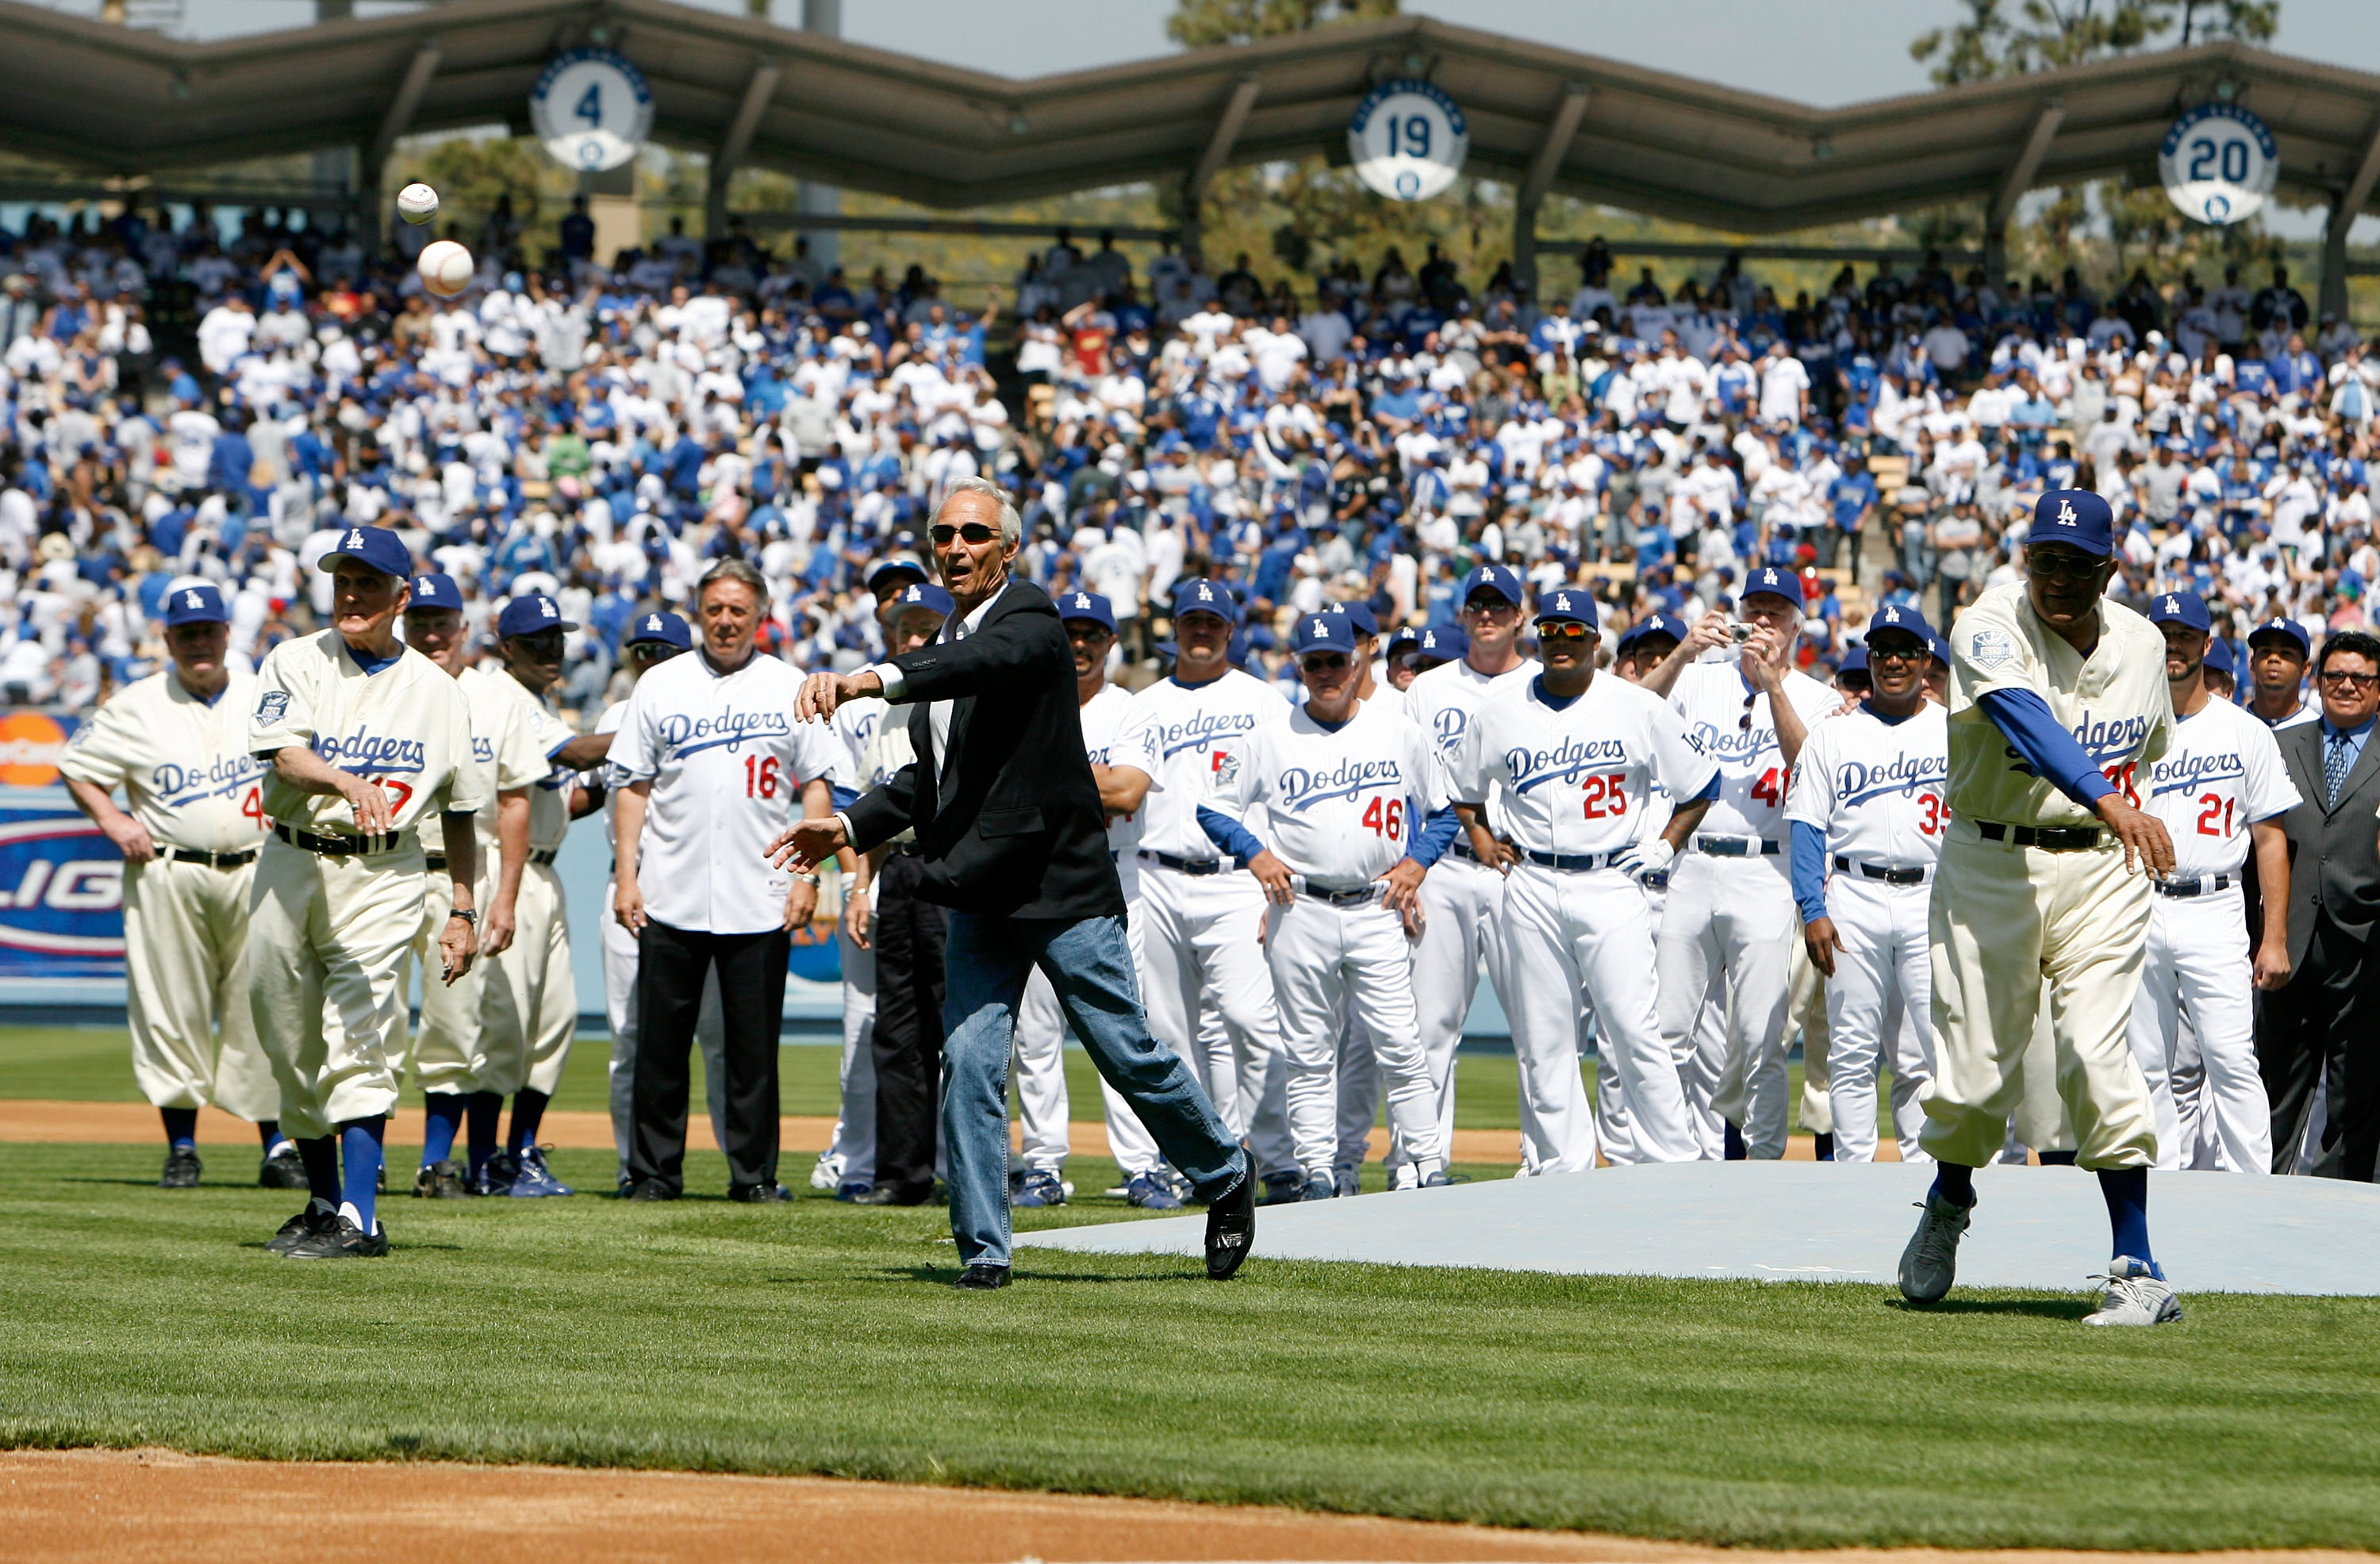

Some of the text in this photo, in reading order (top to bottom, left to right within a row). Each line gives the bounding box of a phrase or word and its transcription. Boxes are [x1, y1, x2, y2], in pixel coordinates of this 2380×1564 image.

[574, 81, 601, 128] 4
[1388, 113, 1430, 158] 19
[2190, 137, 2248, 182] 20
[2057, 499, 2078, 527] LA
[346, 527, 365, 549] LA
[418, 577, 436, 596] LA
[906, 584, 922, 603] LA
[1198, 584, 1213, 602] LA
[1480, 566, 1495, 582] LA
[1763, 567, 1778, 586] LA
[185, 588, 205, 609] LA
[538, 597, 558, 618] LA
[1075, 592, 1091, 609] LA
[1556, 592, 1571, 611] LA
[1885, 606, 1900, 623] LA
[2164, 595, 2181, 615] LA
[647, 614, 663, 631] LA
[1313, 619, 1329, 638] LA
[312, 724, 425, 779] odgers
[659, 703, 790, 758] Dodgers
[1694, 721, 1779, 768] Dodge
[745, 753, 780, 799] 16
[1280, 757, 1402, 812] Dodgers
[1507, 734, 1627, 793] Dodgers
[1837, 749, 1948, 807] Dodger
[2144, 749, 2245, 797] odgers
[241, 787, 273, 831] 4
[1361, 795, 1403, 841] 46
[1582, 773, 1628, 820] 25
[2197, 792, 2236, 838] 21
[0, 859, 125, 910] IG
